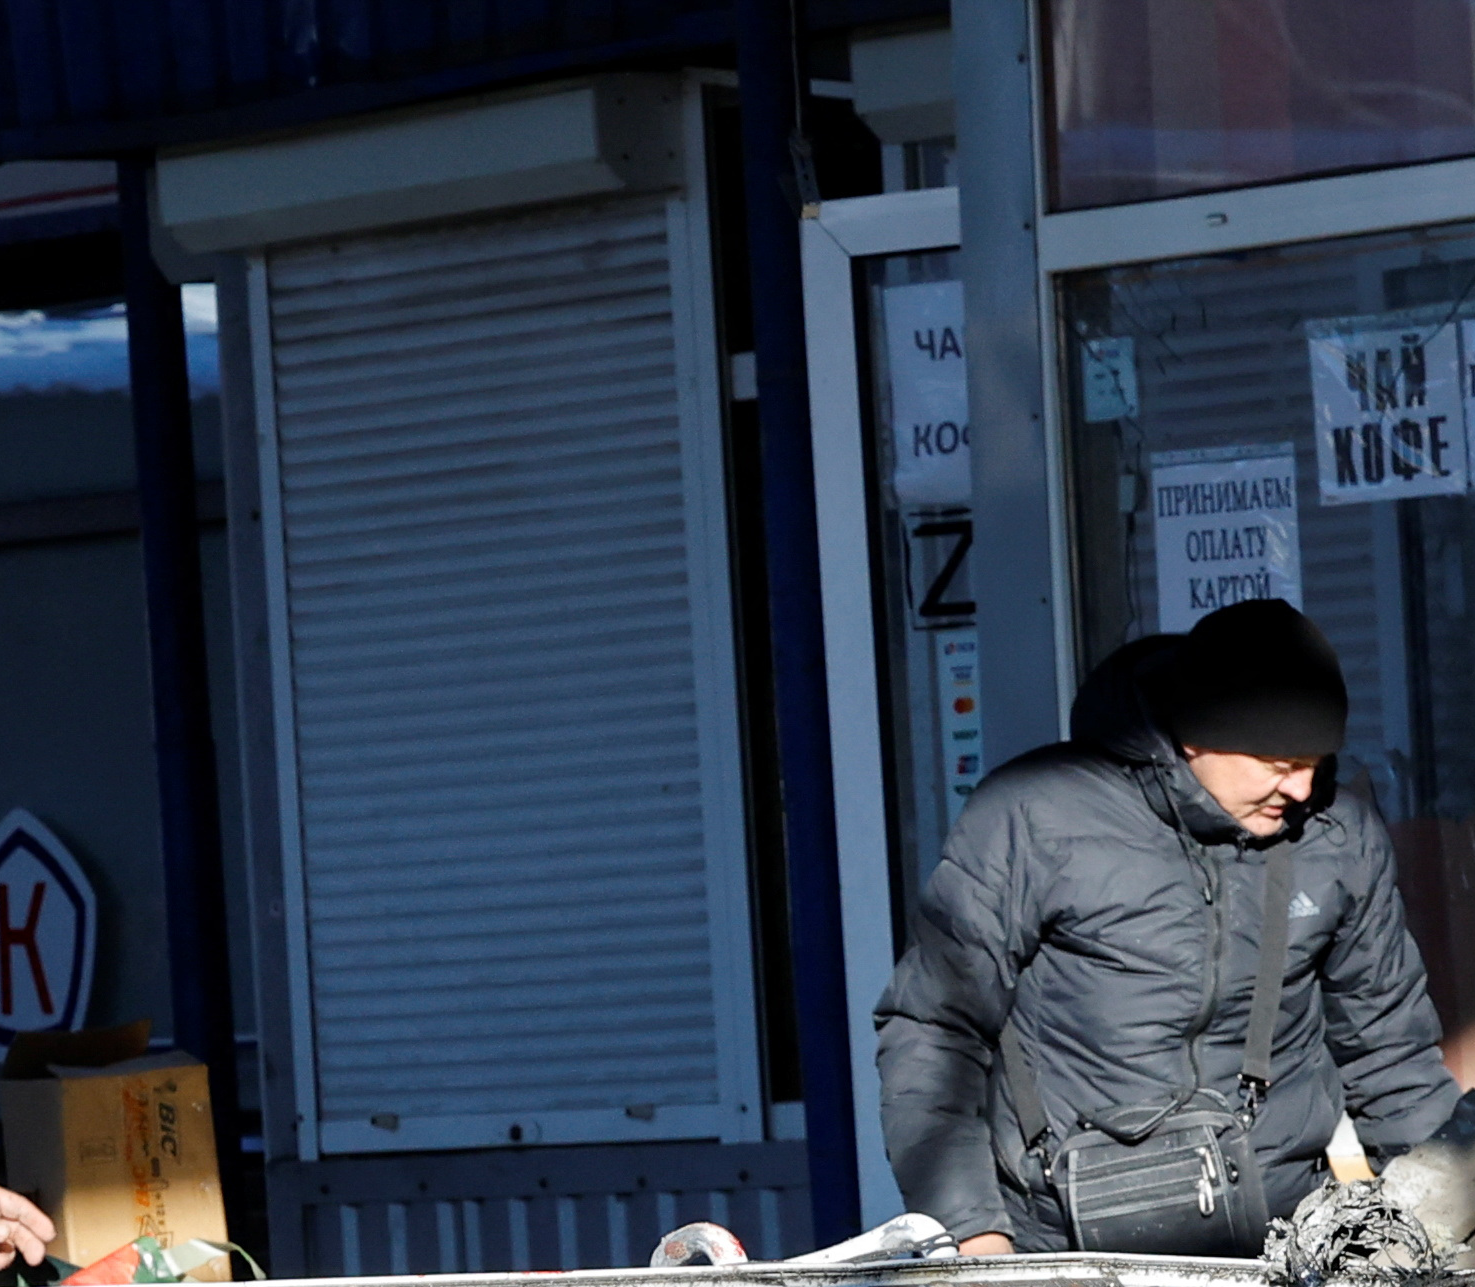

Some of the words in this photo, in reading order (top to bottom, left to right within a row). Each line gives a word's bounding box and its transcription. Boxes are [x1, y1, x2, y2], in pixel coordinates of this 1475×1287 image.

[913, 326, 962, 361] ЧА
[1344, 333, 1426, 411] ЧАЙ
[1333, 415, 1450, 488] КОФЕ
[1157, 476, 1293, 518] ПРИНИМАЕМ
[1185, 525, 1267, 562] ОПЛАТУ
[913, 520, 976, 617] Z
[1189, 566, 1271, 609] КАРТОЙ
